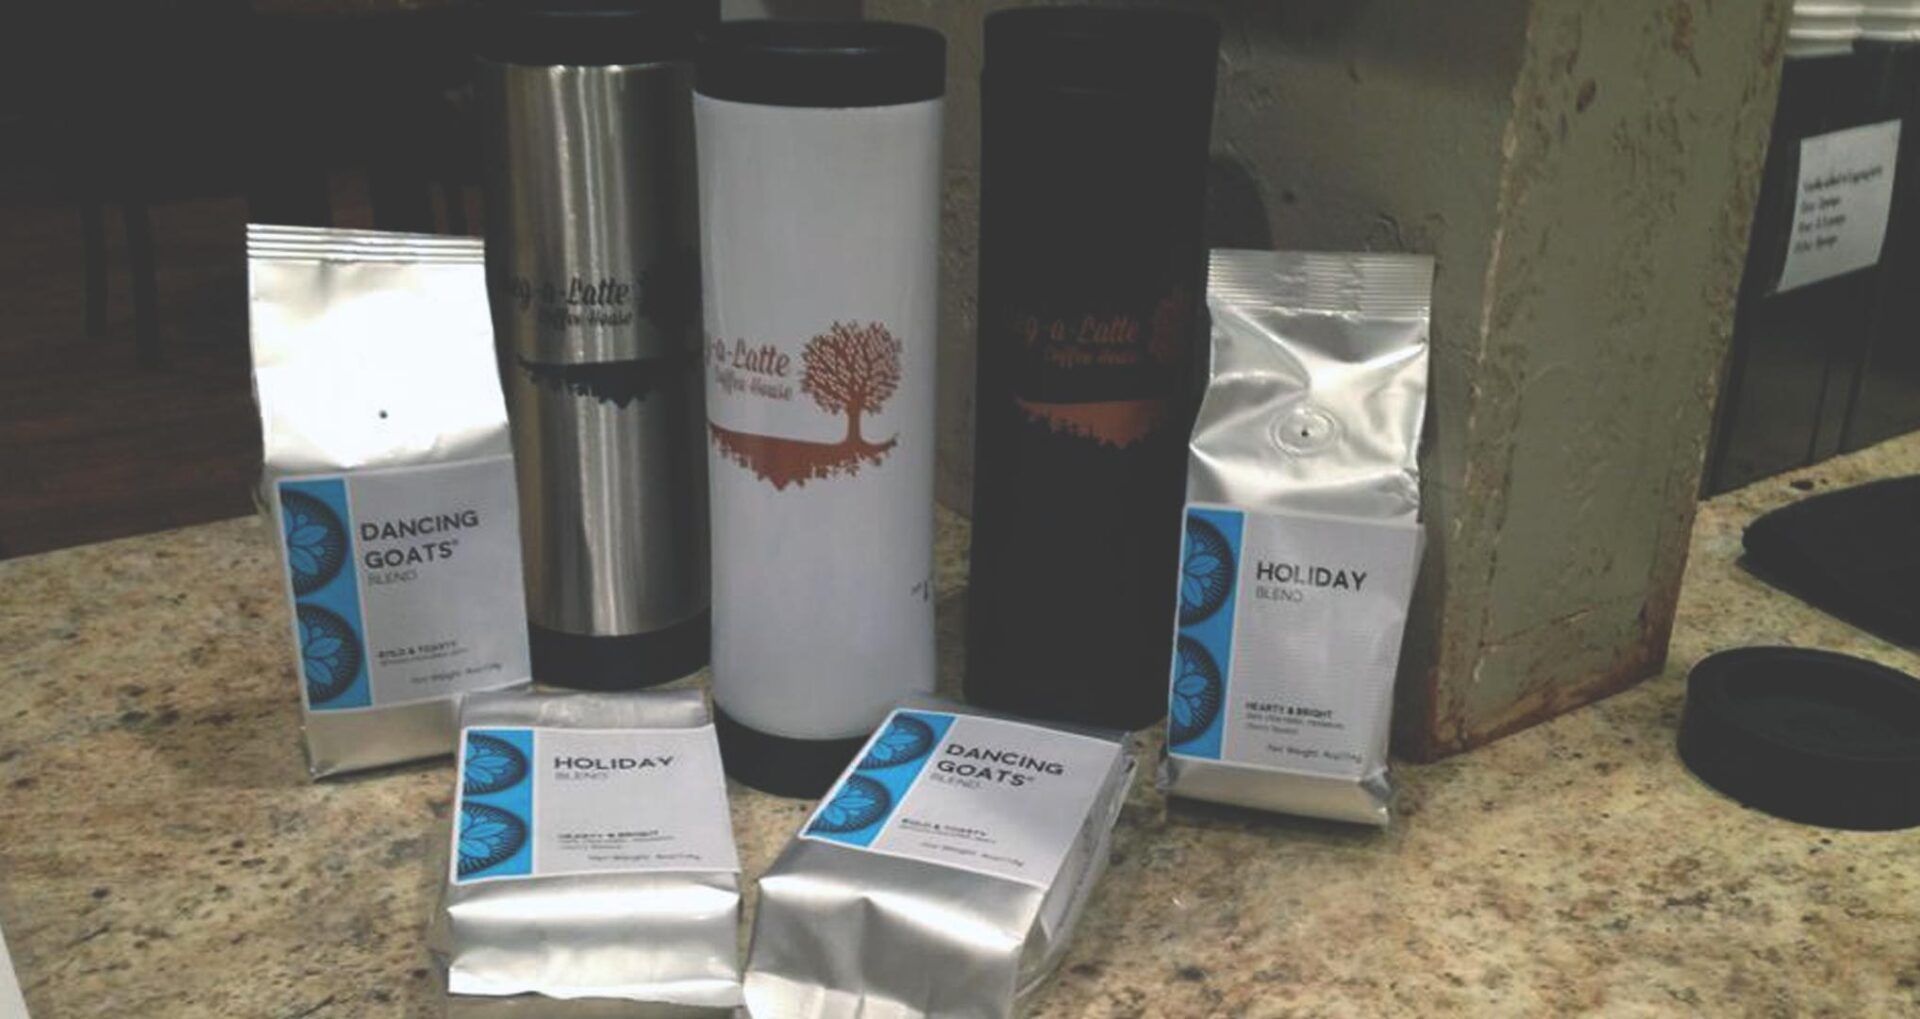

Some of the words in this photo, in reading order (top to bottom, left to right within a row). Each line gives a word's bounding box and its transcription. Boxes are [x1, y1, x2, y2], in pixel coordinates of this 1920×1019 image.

[360, 510, 480, 541] DANCING
[367, 569, 418, 586] BLEND
[1256, 561, 1367, 591] HOLIDAY
[1256, 586, 1303, 602] BLEND
[553, 756, 674, 771] HOLIDAY
[946, 743, 1064, 775] DANCING
